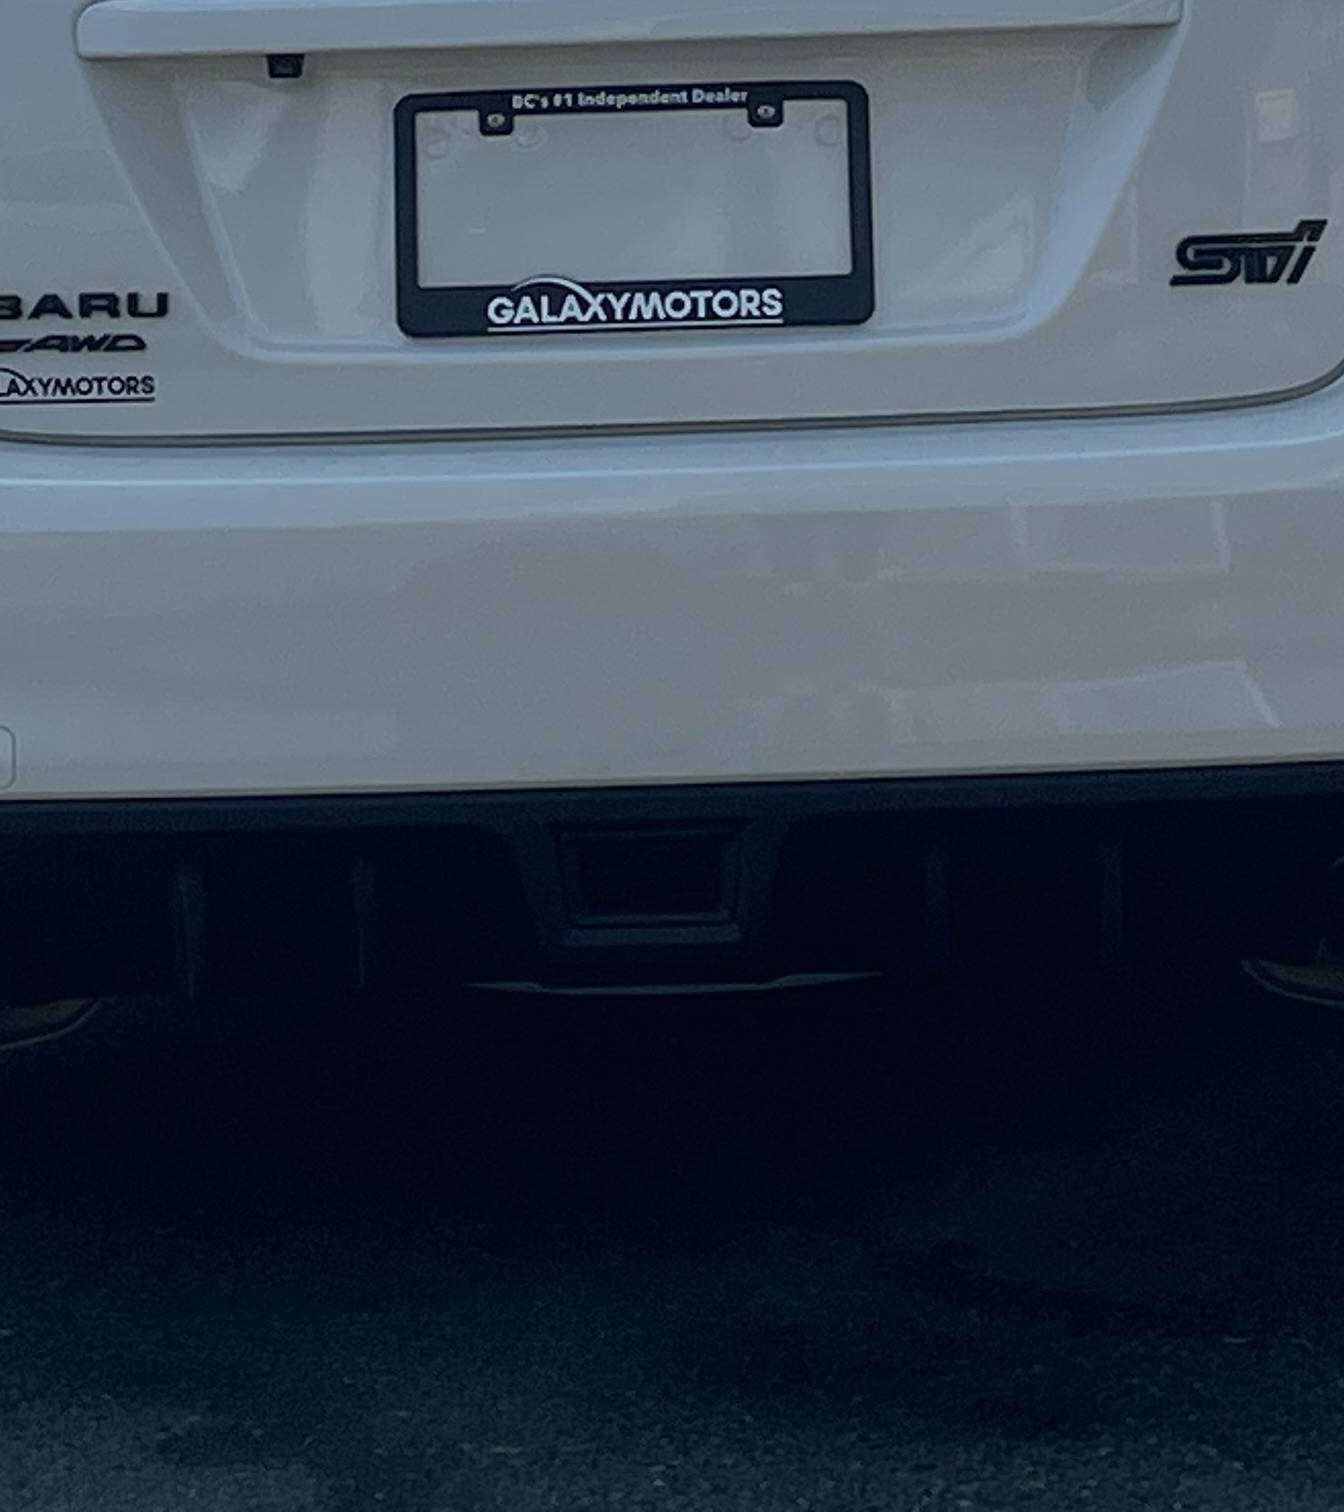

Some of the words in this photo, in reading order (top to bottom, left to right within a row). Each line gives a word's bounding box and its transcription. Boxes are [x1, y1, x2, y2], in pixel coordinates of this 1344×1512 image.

[511, 94, 549, 110] BC's
[553, 93, 573, 108] #1
[577, 90, 688, 110] Independent
[692, 88, 749, 104] Dealer
[23, 334, 147, 354] AWD
